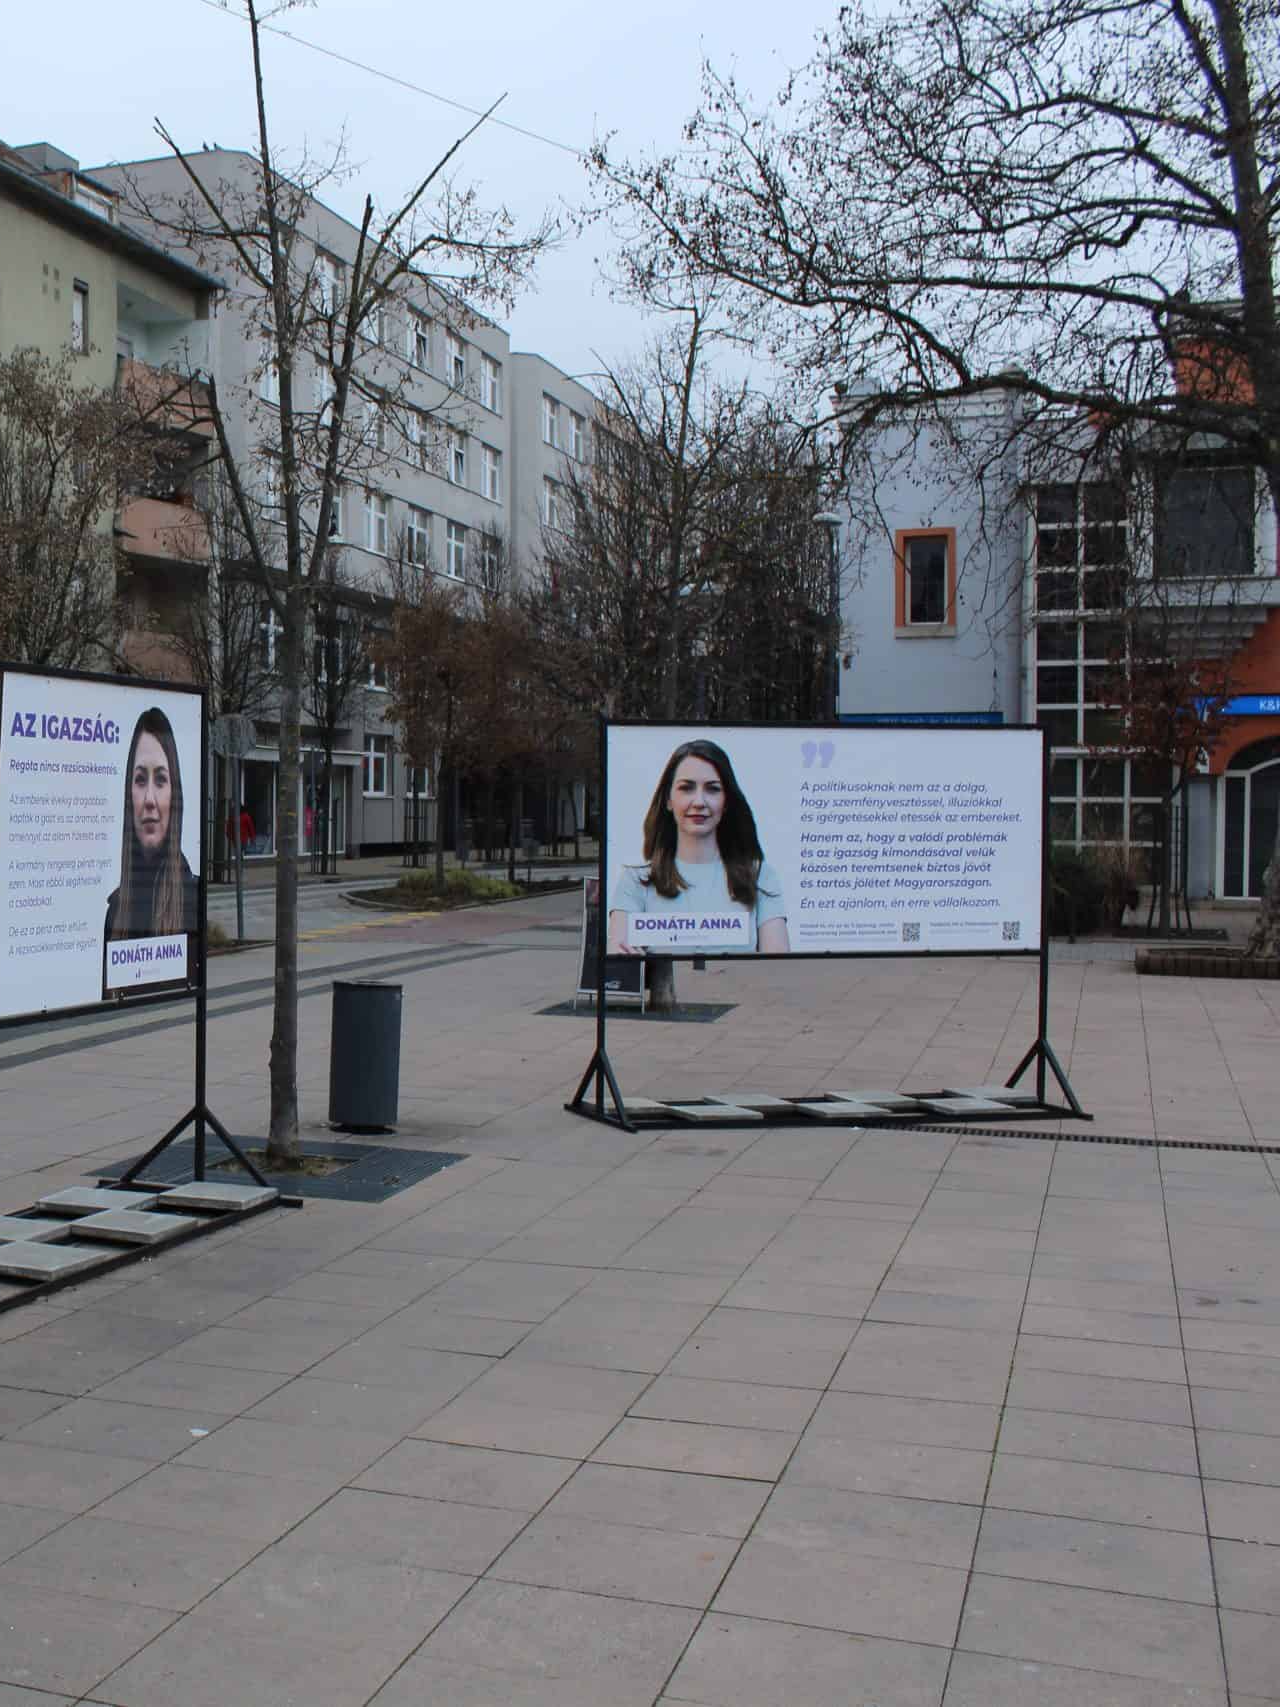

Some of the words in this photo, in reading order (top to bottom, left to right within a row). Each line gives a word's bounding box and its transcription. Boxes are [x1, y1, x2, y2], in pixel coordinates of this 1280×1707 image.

[10, 712, 36, 738] AZ
[41, 712, 120, 744] IGAZSÁG:
[40, 760, 60, 773] nincs
[800, 782, 809, 792] A
[812, 780, 895, 794] politikusoknak
[898, 783, 924, 792] nem
[927, 784, 941, 792] az
[943, 784, 951, 792] a
[953, 781, 988, 794] dolga,
[800, 796, 829, 810] hogy
[800, 812, 814, 822] és
[945, 814, 958, 822] az
[960, 812, 1023, 822] embereket.
[800, 832, 843, 842] Hanem
[846, 834, 862, 843] az,
[866, 832, 895, 844] hogy
[898, 834, 905, 842] a
[909, 831, 944, 842] valódi
[946, 831, 1008, 844] problémák
[800, 847, 814, 857] és
[816, 849, 830, 857] az
[833, 847, 878, 860] igazság
[881, 847, 962, 857] kimondásával
[965, 847, 996, 857] velük
[800, 863, 848, 873] közösen
[851, 863, 924, 873] teremtsenek
[927, 862, 960, 872] biztos
[800, 878, 813, 888] és
[816, 878, 851, 888] tartós
[854, 878, 890, 890] jólétet
[894, 878, 992, 890] Magyarországon.
[800, 896, 815, 909] Én
[818, 898, 835, 909] ezt
[838, 897, 888, 911] ajánlom,
[891, 897, 904, 909] én
[907, 899, 929, 909] erre
[933, 896, 1001, 908] vállalkozom.
[635, 916, 696, 930] DONÁTH
[700, 917, 742, 929] ANNA
[111, 944, 153, 965] DONÁTH
[155, 944, 183, 960] ANNA
